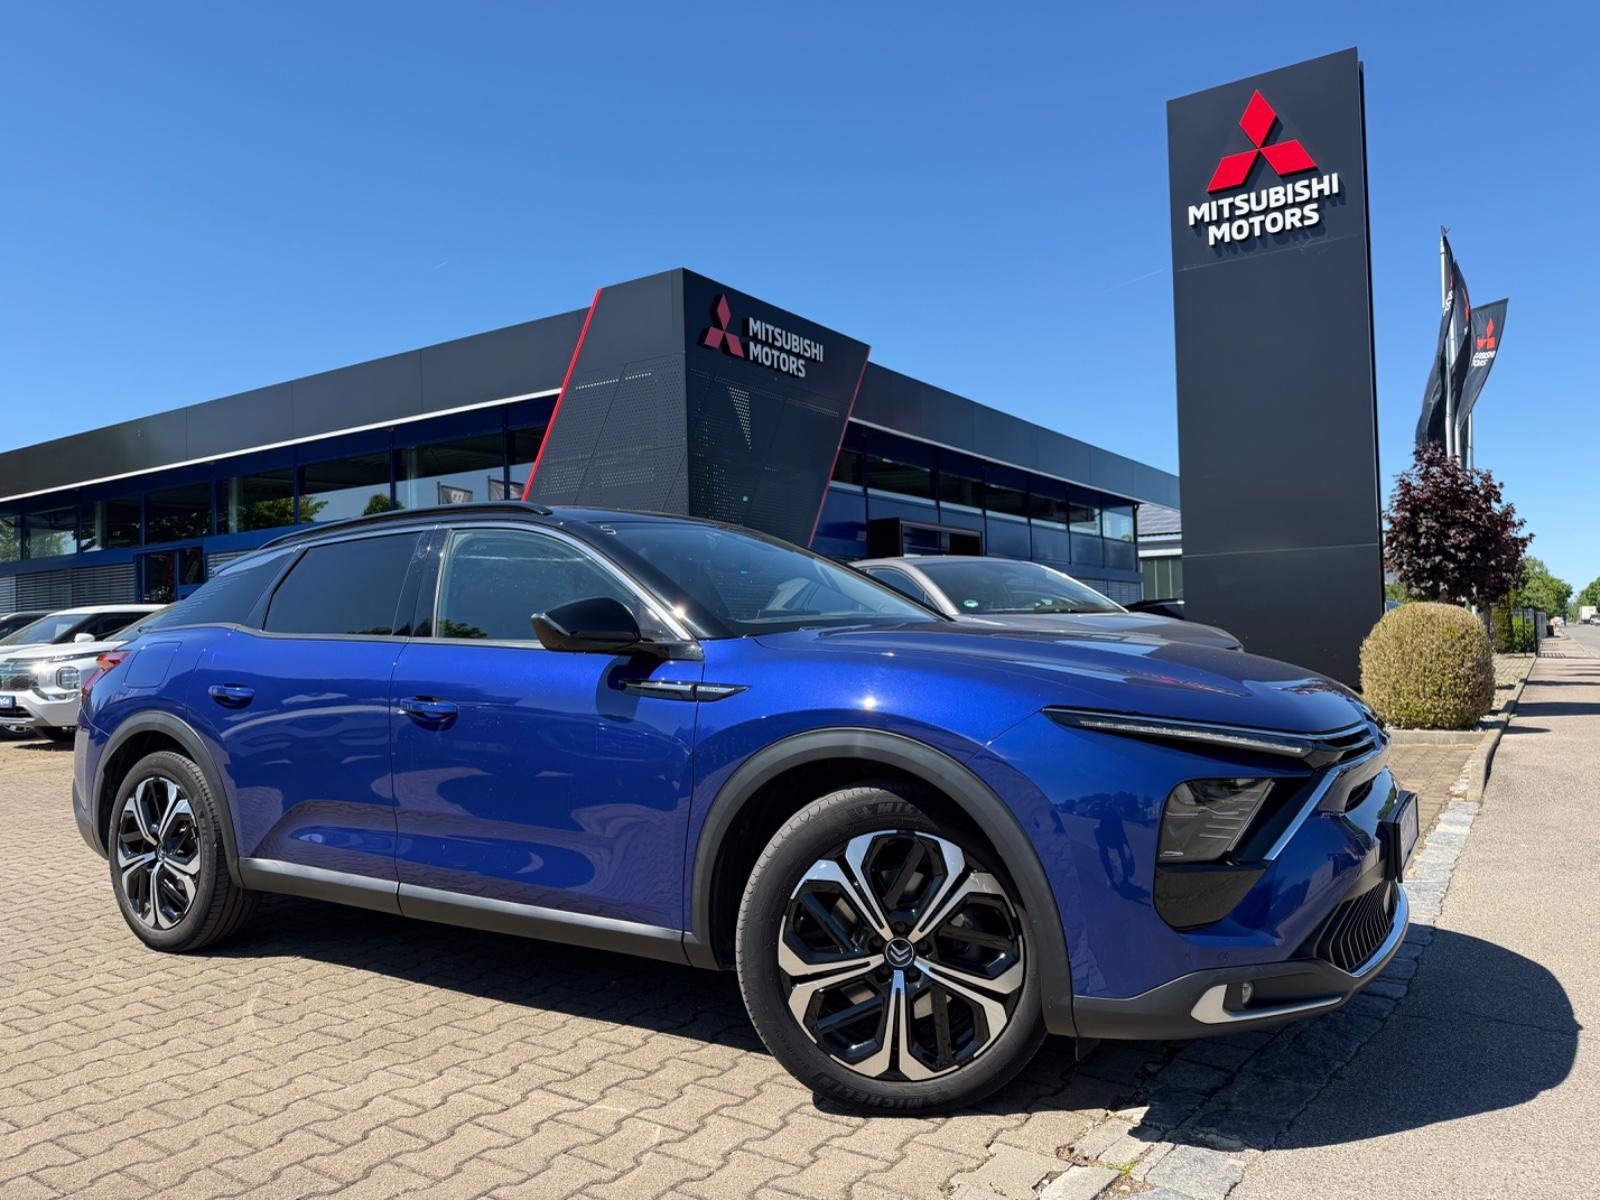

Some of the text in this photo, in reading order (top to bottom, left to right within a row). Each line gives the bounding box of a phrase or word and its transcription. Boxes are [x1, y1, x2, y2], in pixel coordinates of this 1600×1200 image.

[1188, 173, 1339, 226] MITSUBISHI
[1208, 203, 1320, 246] MOTORS
[749, 317, 824, 362] MITSUBISHI
[749, 342, 806, 378] MOTORS
